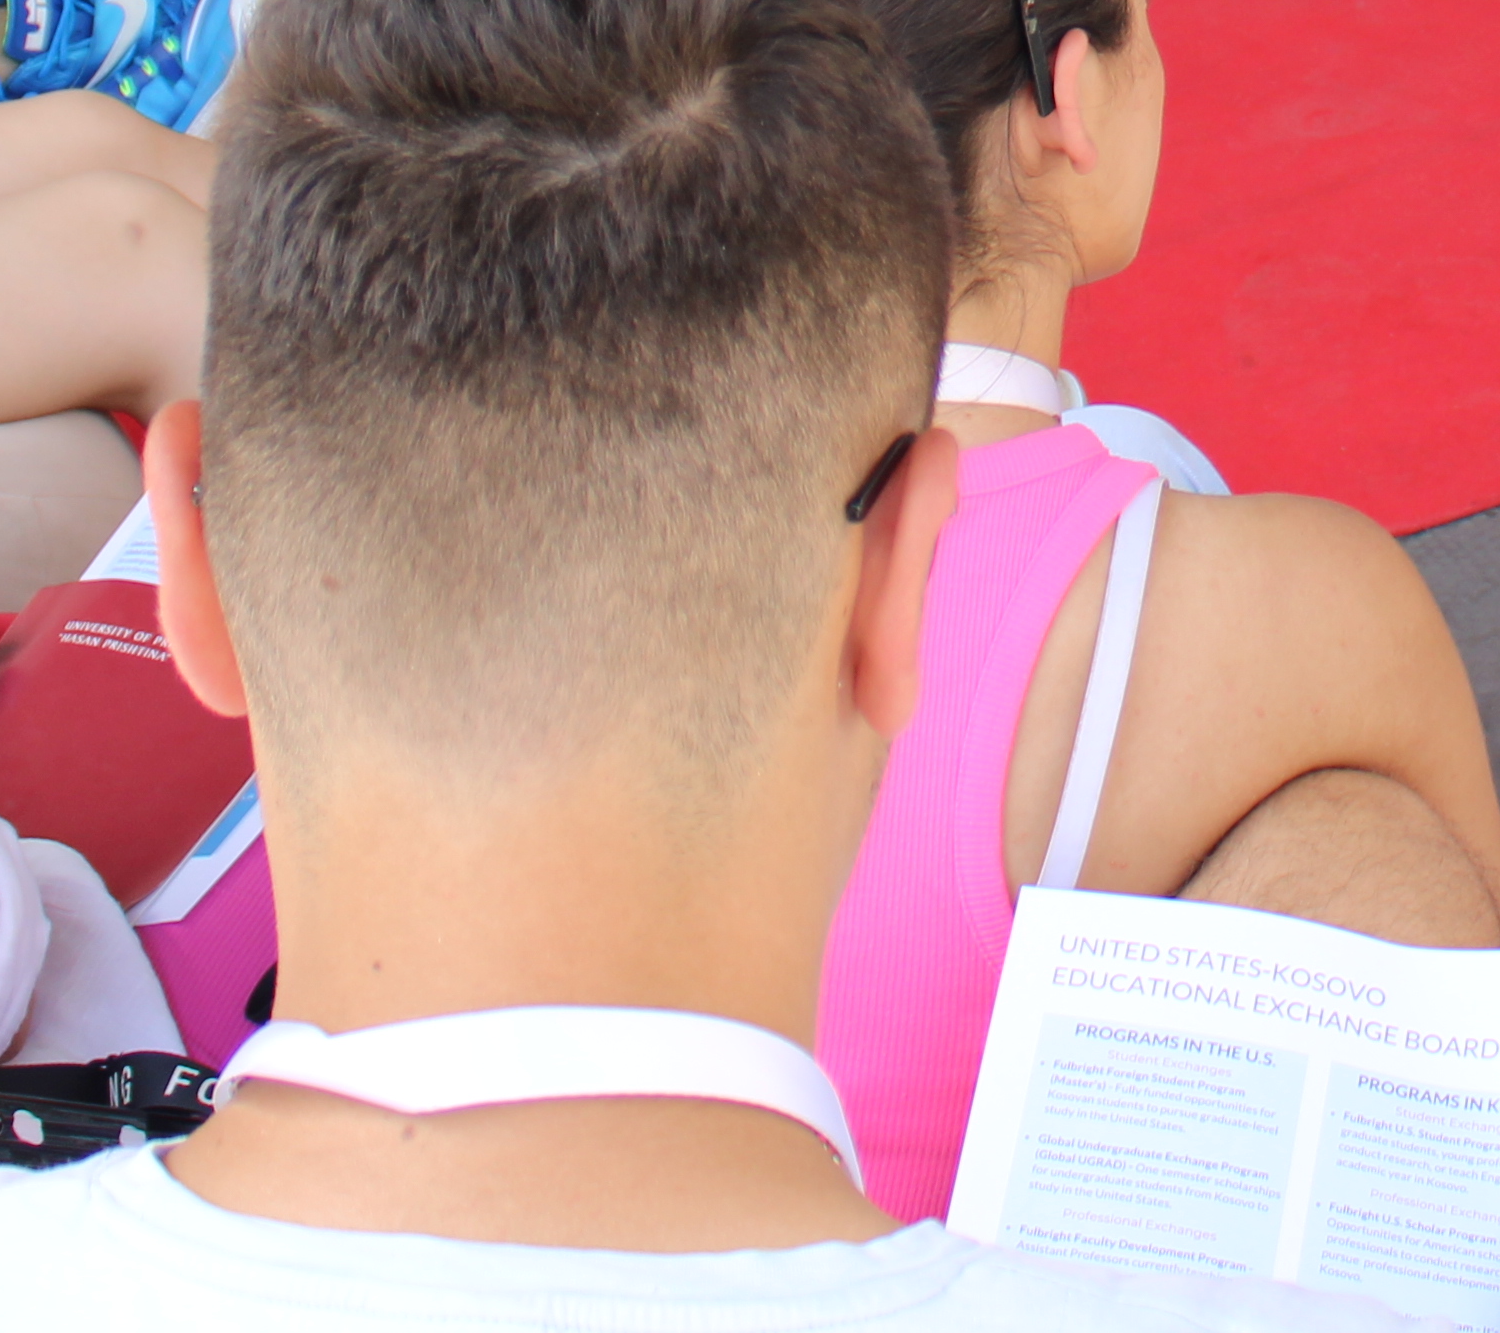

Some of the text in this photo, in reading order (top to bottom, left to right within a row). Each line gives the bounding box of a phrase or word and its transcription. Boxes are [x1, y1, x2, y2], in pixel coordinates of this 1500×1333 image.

[64, 620, 134, 639] UNIVERSITY
[133, 631, 152, 642] OF
[1059, 935, 1386, 1008] UNITED STATES-KOSOVO
[1052, 967, 1500, 1060] EDUCATIONAL EXCHANGE BOARD
[1075, 1023, 1276, 1067] PROGRAMS IN THE U.S.
[1054, 1059, 1246, 1099] Fulbright Foreign Student Program
[1108, 1049, 1232, 1079] Student Exchanges
[1115, 1083, 1141, 1098] Fully
[1143, 1087, 1182, 1103] funded
[1185, 1095, 1258, 1117] opportunities
[1260, 1104, 1276, 1119] for
[1358, 1074, 1460, 1108] PROGRAMS
[1464, 1096, 1483, 1111] IN
[1045, 1104, 1186, 1133] study in the United States.
[1047, 1089, 1280, 1135] Kosovan students to pursue graduate-level
[1343, 1111, 1393, 1132] Fulbright
[1395, 1124, 1415, 1137] U.S.
[1418, 1129, 1460, 1146] Student
[1395, 1106, 1446, 1126] Student
[1038, 1134, 1269, 1181] Global Undergraduate Exchange Program
[1338, 1142, 1382, 1161] conduct
[1384, 1152, 1431, 1172] research,
[1435, 1163, 1446, 1174] or
[1449, 1165, 1478, 1181] teach
[1341, 1128, 1388, 1147] graduate
[1390, 1137, 1439, 1157] students,
[1441, 1149, 1474, 1166] young
[1032, 1164, 1269, 1212] for undergraduate students from Kosovo to
[1035, 1149, 1076, 1165] (Global
[1078, 1155, 1127, 1172] UGRAD)
[1135, 1163, 1160, 1177] One
[1162, 1169, 1212, 1184] semester
[1214, 1176, 1281, 1200] scholarships
[1336, 1158, 1469, 1194] academic year in Kosovo.
[1029, 1179, 1172, 1209] study in the United States.
[1370, 1189, 1448, 1214] Professional
[1063, 1208, 1216, 1242] Professional Exchanges
[1327, 1218, 1403, 1245] Opportunities
[1405, 1233, 1421, 1246] for
[1423, 1240, 1475, 1257] American
[1329, 1202, 1380, 1223] Fulbright
[1382, 1213, 1403, 1227] U.S.
[1405, 1218, 1446, 1236] Scholar
[1449, 1228, 1497, 1246] Program
[1016, 1240, 1068, 1258] Assistant
[1070, 1248, 1130, 1266] Professors
[1020, 1225, 1072, 1243] Fulbright
[1073, 1233, 1117, 1251] Faculty
[1118, 1240, 1196, 1262] Development
[1197, 1252, 1247, 1273] Program
[1322, 1249, 1360, 1268] pursue
[1363, 1258, 1430, 1280] professional
[1326, 1234, 1398, 1258] professionals
[1400, 1250, 1412, 1261] to
[1414, 1253, 1458, 1270] conduct
[1319, 1263, 1362, 1283] Kosovo.
